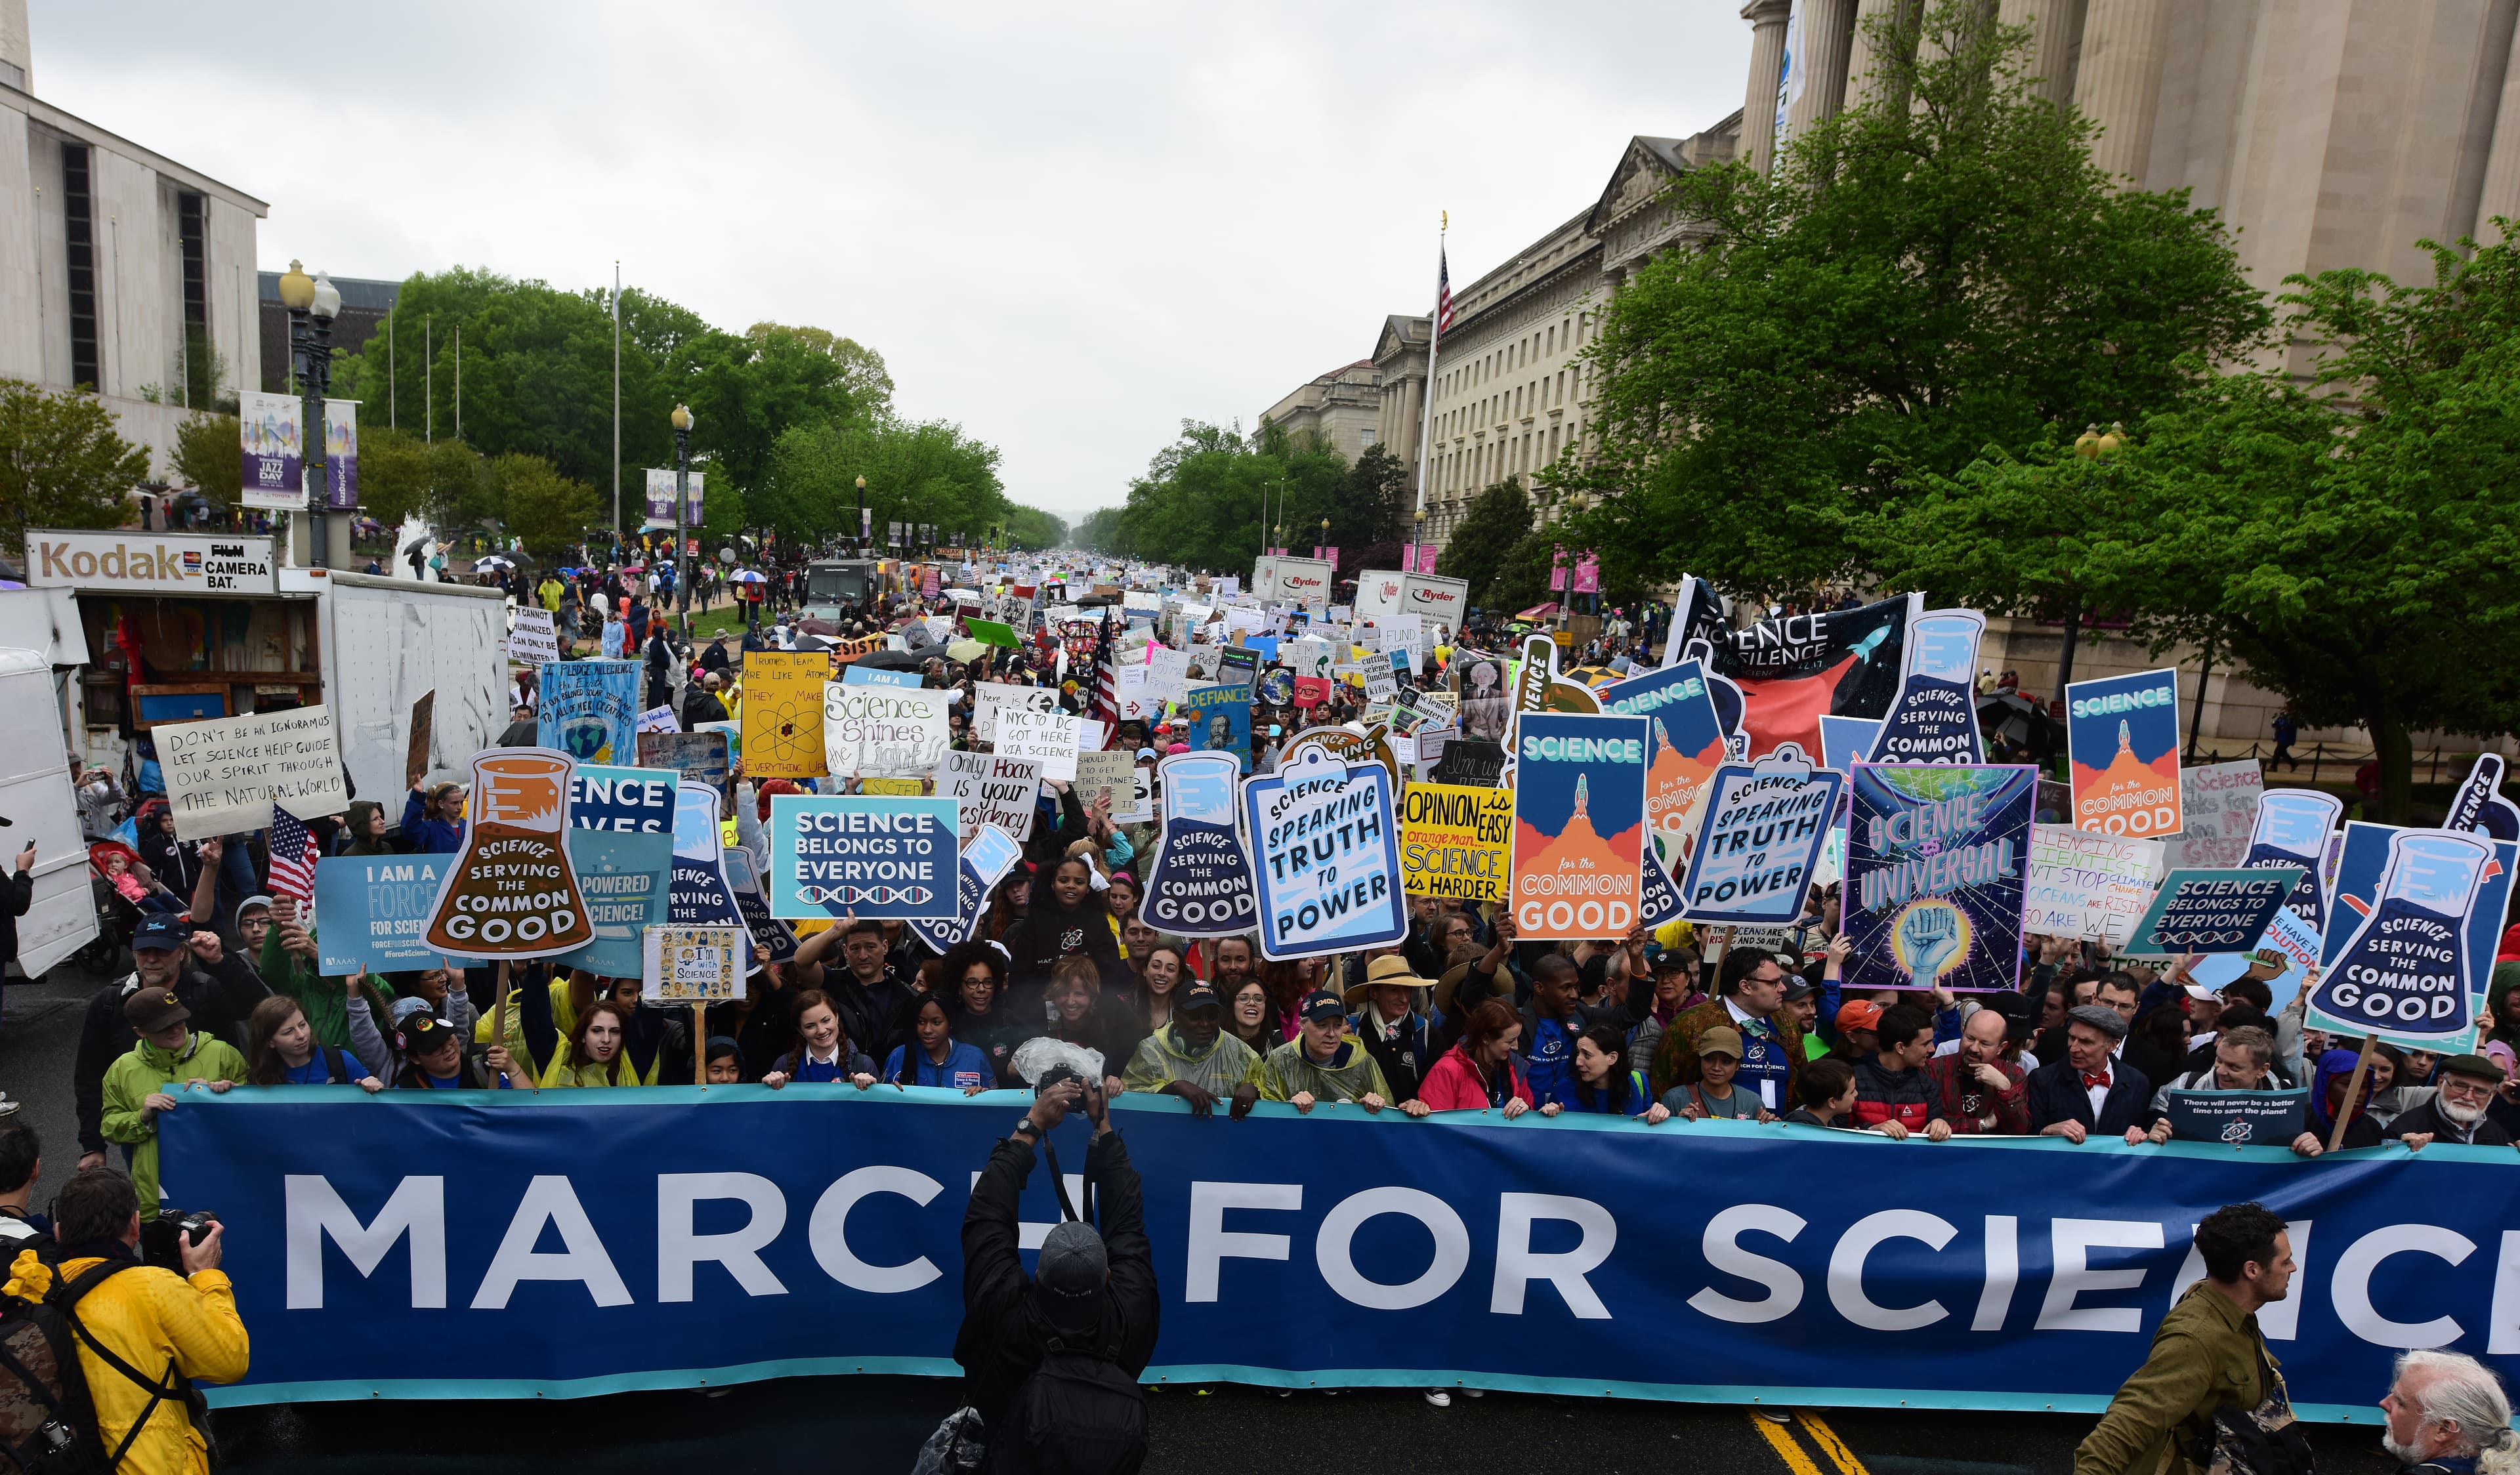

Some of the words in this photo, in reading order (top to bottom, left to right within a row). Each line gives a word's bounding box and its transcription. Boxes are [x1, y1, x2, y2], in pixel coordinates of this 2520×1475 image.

[259, 463, 283, 473] JAZZ
[259, 472, 283, 480] DAY
[40, 542, 184, 581] Kodak
[205, 561, 268, 575] CAMERA
[207, 575, 237, 589] BAT.
[1292, 577, 1322, 587] Ryder
[1383, 581, 1398, 598] Ryder
[960, 598, 986, 607] TRAITOR
[1421, 589, 1456, 602] Ryder
[522, 608, 548, 620] CANNOT
[513, 636, 526, 646] CAN
[528, 638, 544, 649] ONLY
[1387, 629, 1416, 642] FUND
[1295, 645, 1312, 655] I'M
[1362, 654, 1389, 665] cutting
[1738, 642, 1827, 666] SILENCE
[544, 664, 555, 675] I
[560, 665, 591, 676] PLEDGE
[594, 663, 633, 675] ALLEGIENCE
[1293, 655, 1314, 665] WITH
[1364, 663, 1391, 674] science
[743, 671, 761, 679] ARE
[772, 671, 793, 680] LIKE
[805, 671, 830, 680] ATOMS
[1366, 671, 1395, 682] funding
[549, 685, 555, 694] to
[558, 681, 571, 691] the
[576, 677, 605, 689] Earth
[1369, 684, 1392, 696] kills.
[541, 702, 549, 712] OF
[549, 696, 560, 707] OUR
[561, 689, 583, 701] BELOVED
[746, 689, 775, 701] THEY
[794, 690, 824, 702] MAKE
[825, 686, 933, 720] Science
[976, 689, 1001, 703] There
[1011, 694, 1021, 707] is
[1188, 687, 1250, 709] DEFIANCE
[1419, 694, 1451, 713] science
[540, 713, 552, 724] TO
[556, 705, 569, 719] ALL
[569, 704, 576, 713] OF
[578, 701, 592, 711] HER
[596, 700, 632, 727] CREATURES
[648, 709, 673, 722] Neutrons
[1006, 711, 1030, 726] NYC
[1034, 714, 1047, 726] TO
[1057, 716, 1073, 730] DC
[1414, 703, 1446, 722] matters
[170, 729, 225, 752] DON'T
[234, 726, 248, 739] BE
[254, 726, 266, 736] AN
[271, 715, 330, 734] IGNORAMUS
[843, 719, 925, 742] Shines
[1008, 730, 1032, 741] GOT
[1041, 732, 1072, 743] HERE
[173, 752, 197, 766] LET
[205, 746, 259, 763] SCIENCE
[264, 742, 295, 757] HELP
[296, 738, 331, 753] GUIDE
[828, 746, 852, 768] the
[1003, 744, 1022, 755] VIA
[1029, 746, 1073, 758] SCIENCE
[1522, 736, 1641, 761] SCIENCE
[177, 769, 215, 786] OUR
[221, 763, 270, 779] SPIRIT
[278, 757, 334, 773] THROUGH
[745, 762, 802, 773] EVERYTHING
[808, 761, 823, 773] UP
[949, 754, 986, 780] Only
[992, 758, 1034, 780] Hoax
[180, 792, 217, 811] THE
[226, 783, 295, 807] NATURAL
[296, 776, 341, 797] WORLD
[981, 782, 1028, 810] your
[1270, 779, 1349, 821] SCIENCE
[1268, 785, 1376, 849] SPEAKING
[1406, 791, 1480, 827] OPINION
[1482, 791, 1511, 810] is
[795, 811, 933, 833] SCIENCE
[1477, 814, 1511, 844] EASY
[1868, 793, 1981, 851] SCIENCE
[478, 839, 555, 860] SCIENCE
[795, 838, 897, 854] BELONGS
[903, 839, 933, 854] TO
[1173, 832, 1231, 850] SCIENCE
[1269, 812, 1380, 880] TRUTH
[1920, 838, 1941, 854] IS
[795, 860, 933, 880] EVERYONE
[1169, 854, 1238, 867] SERVING
[1404, 844, 1502, 879] SCIENCE
[1557, 857, 1576, 873] for
[1578, 856, 1595, 869] the
[470, 863, 561, 880] SERVING
[1190, 868, 1212, 878] THE
[1317, 866, 1337, 887] TO
[1861, 838, 2012, 907] UNIVERSAL
[2059, 867, 2109, 891] STOP
[2109, 874, 2153, 888] CLIMATE
[497, 881, 526, 891] THE
[582, 875, 650, 894] POWERED
[1161, 875, 1248, 897] COMMON
[1404, 874, 1425, 890] is
[1430, 876, 1498, 900] HARDER
[1521, 874, 1632, 896] COMMON
[2107, 883, 2143, 896] CHANGE
[455, 889, 570, 912] COMMON
[1156, 893, 1254, 924] GOOD
[1278, 874, 1387, 940] POWER
[1519, 901, 1632, 931] GOOD
[446, 909, 576, 944] GOOD
[2381, 919, 2453, 942] SCIENCE
[385, 950, 430, 959] #Force4Science
[2368, 939, 2454, 963] SERVING
[595, 958, 615, 966] AAAS
[2390, 957, 2418, 970] THE
[2347, 965, 2456, 992] COMMON
[1190, 987, 1214, 997] EMORY
[1316, 998, 1340, 1007] EMORY
[2332, 983, 2456, 1021] GOOD
[1185, 1181, 1618, 1319] FOR
